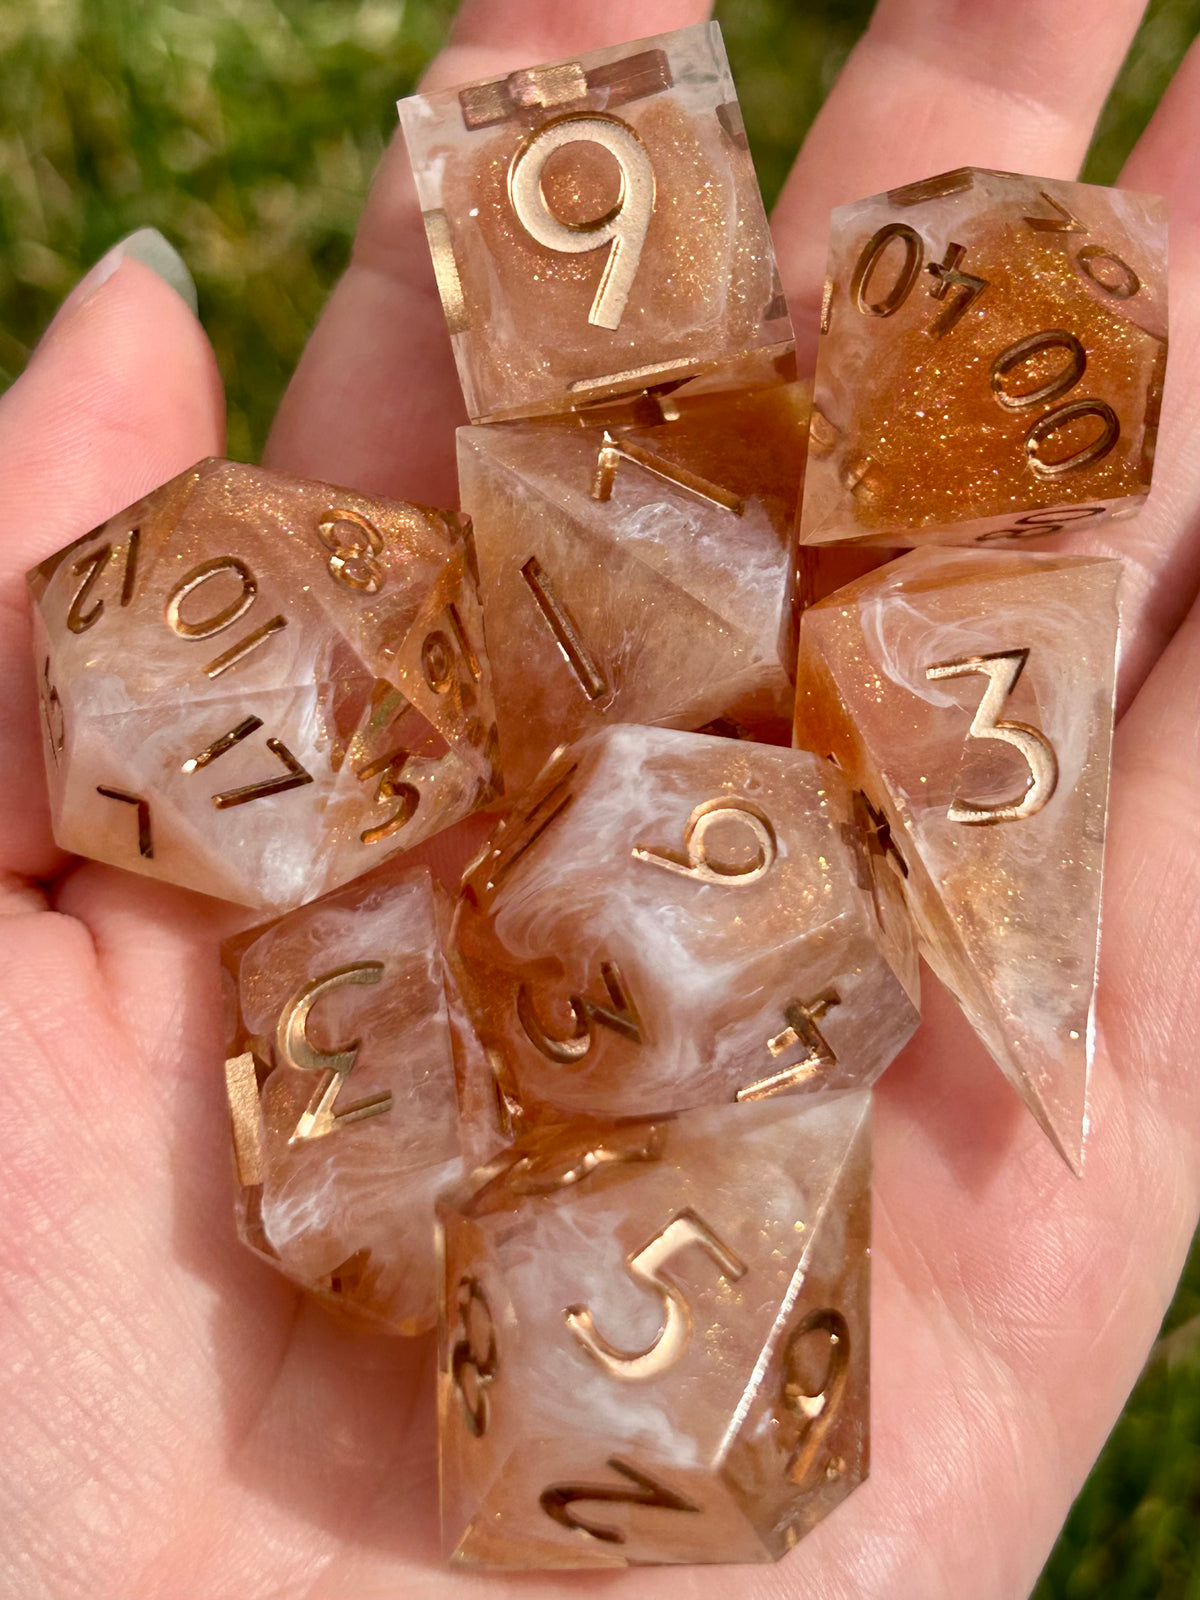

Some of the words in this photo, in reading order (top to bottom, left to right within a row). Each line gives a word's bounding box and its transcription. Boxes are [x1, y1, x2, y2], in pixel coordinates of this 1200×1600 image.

[850, 222, 991, 340] 40
[990, 328, 1121, 482] 00
[318, 507, 386, 596] 8
[164, 555, 288, 679] 10
[926, 647, 1059, 826] 3
[358, 746, 420, 845] 3
[516, 961, 642, 1065] 3
[734, 988, 842, 1103] 4
[561, 1206, 748, 1382] 5
[538, 1453, 703, 1545] 2
